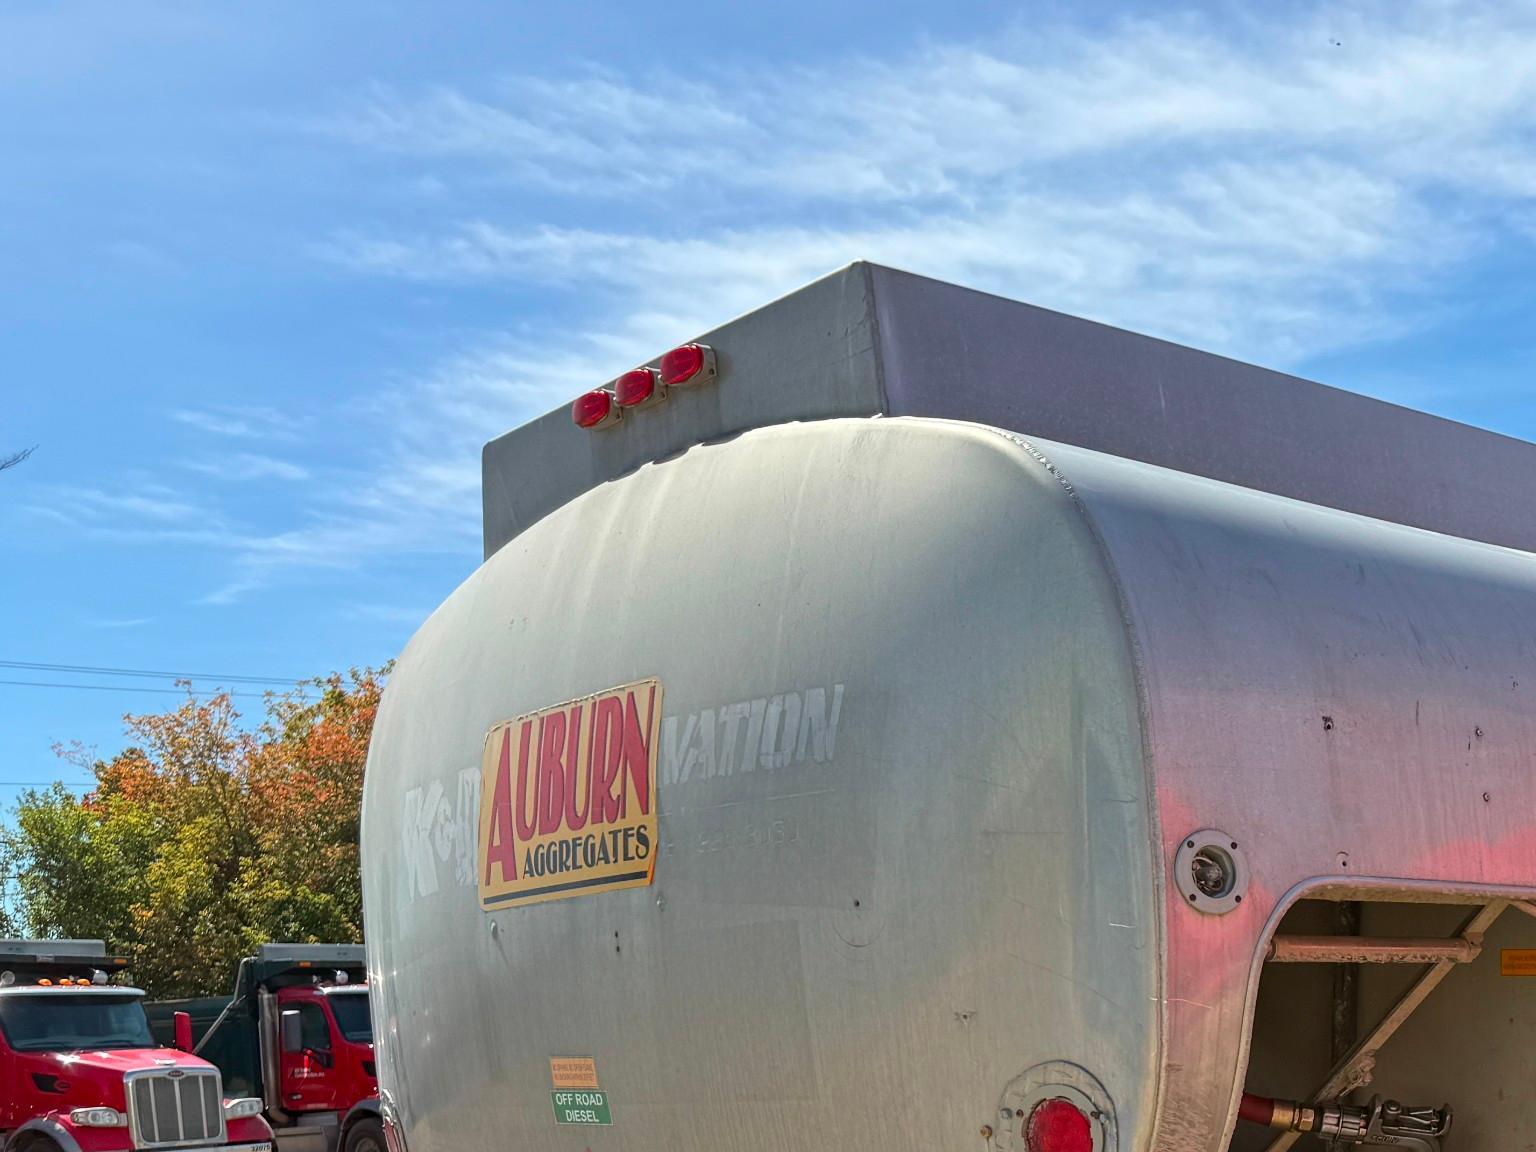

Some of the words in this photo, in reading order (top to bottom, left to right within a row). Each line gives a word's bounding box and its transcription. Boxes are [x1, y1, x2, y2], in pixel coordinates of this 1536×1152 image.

[485, 685, 656, 887] AUBURN
[522, 825, 650, 879] AGGREGATES
[555, 1093, 574, 1106] OFF
[575, 1093, 603, 1106] ROAD
[565, 1109, 600, 1123] DIESEL
